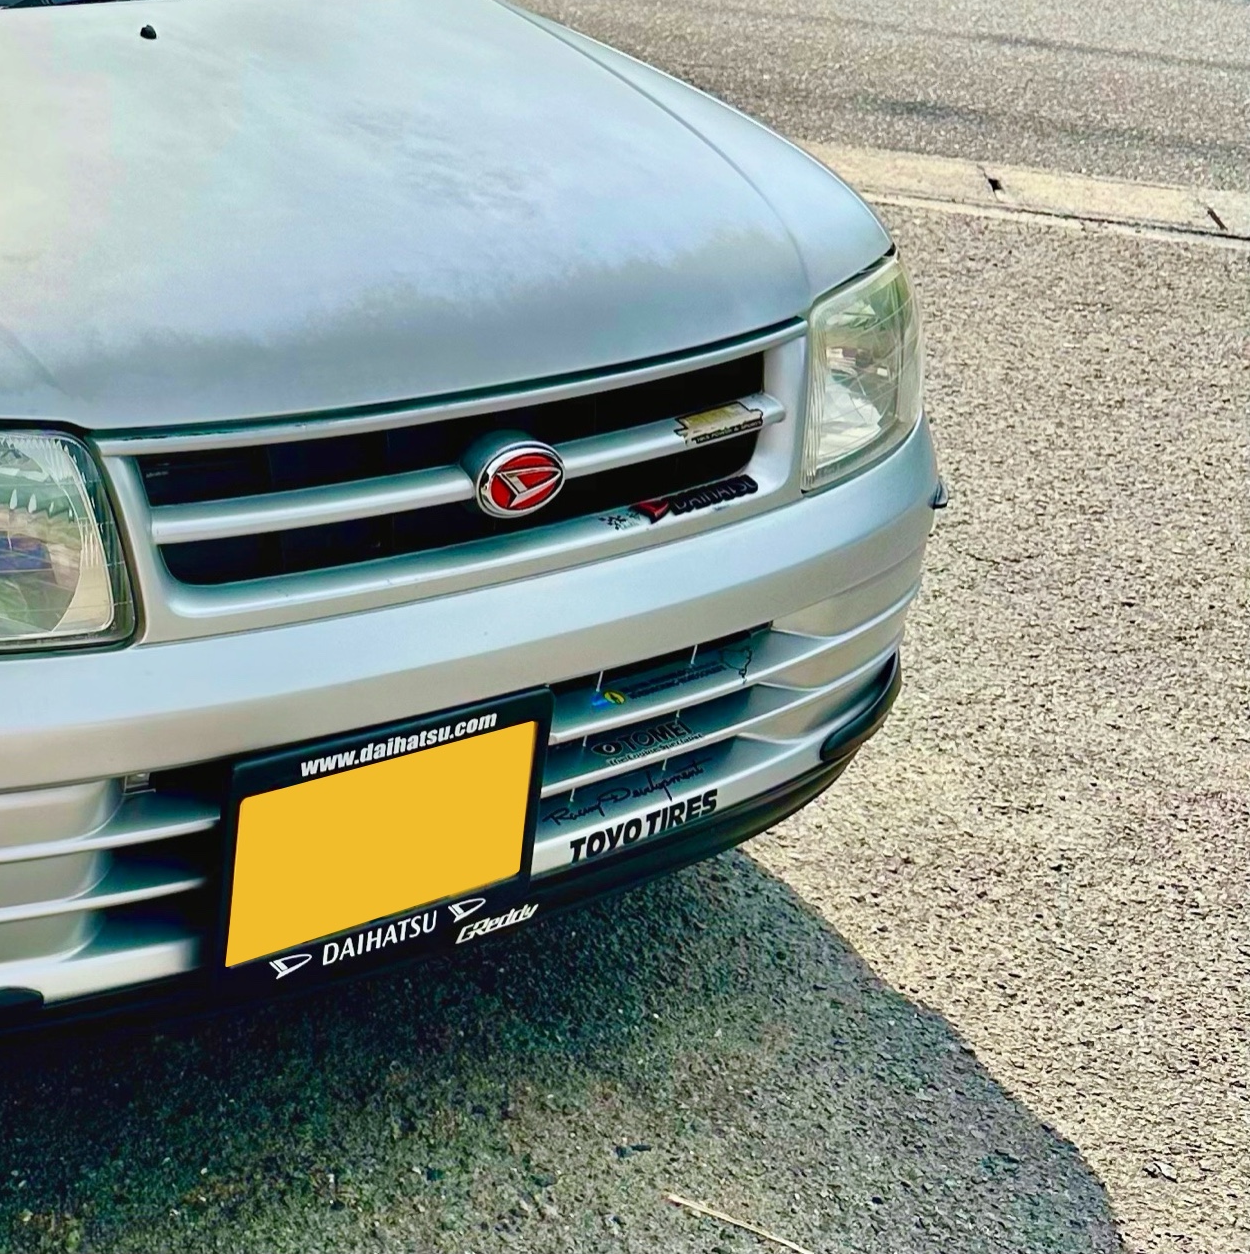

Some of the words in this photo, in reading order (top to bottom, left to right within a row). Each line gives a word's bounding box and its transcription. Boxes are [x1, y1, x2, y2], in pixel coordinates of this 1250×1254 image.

[300, 712, 498, 778] www.daihatsu.com
[569, 817, 643, 864] TOYO
[645, 788, 719, 837] TIRES
[322, 910, 438, 966] DAIHATSU
[455, 903, 539, 945] GReddy
